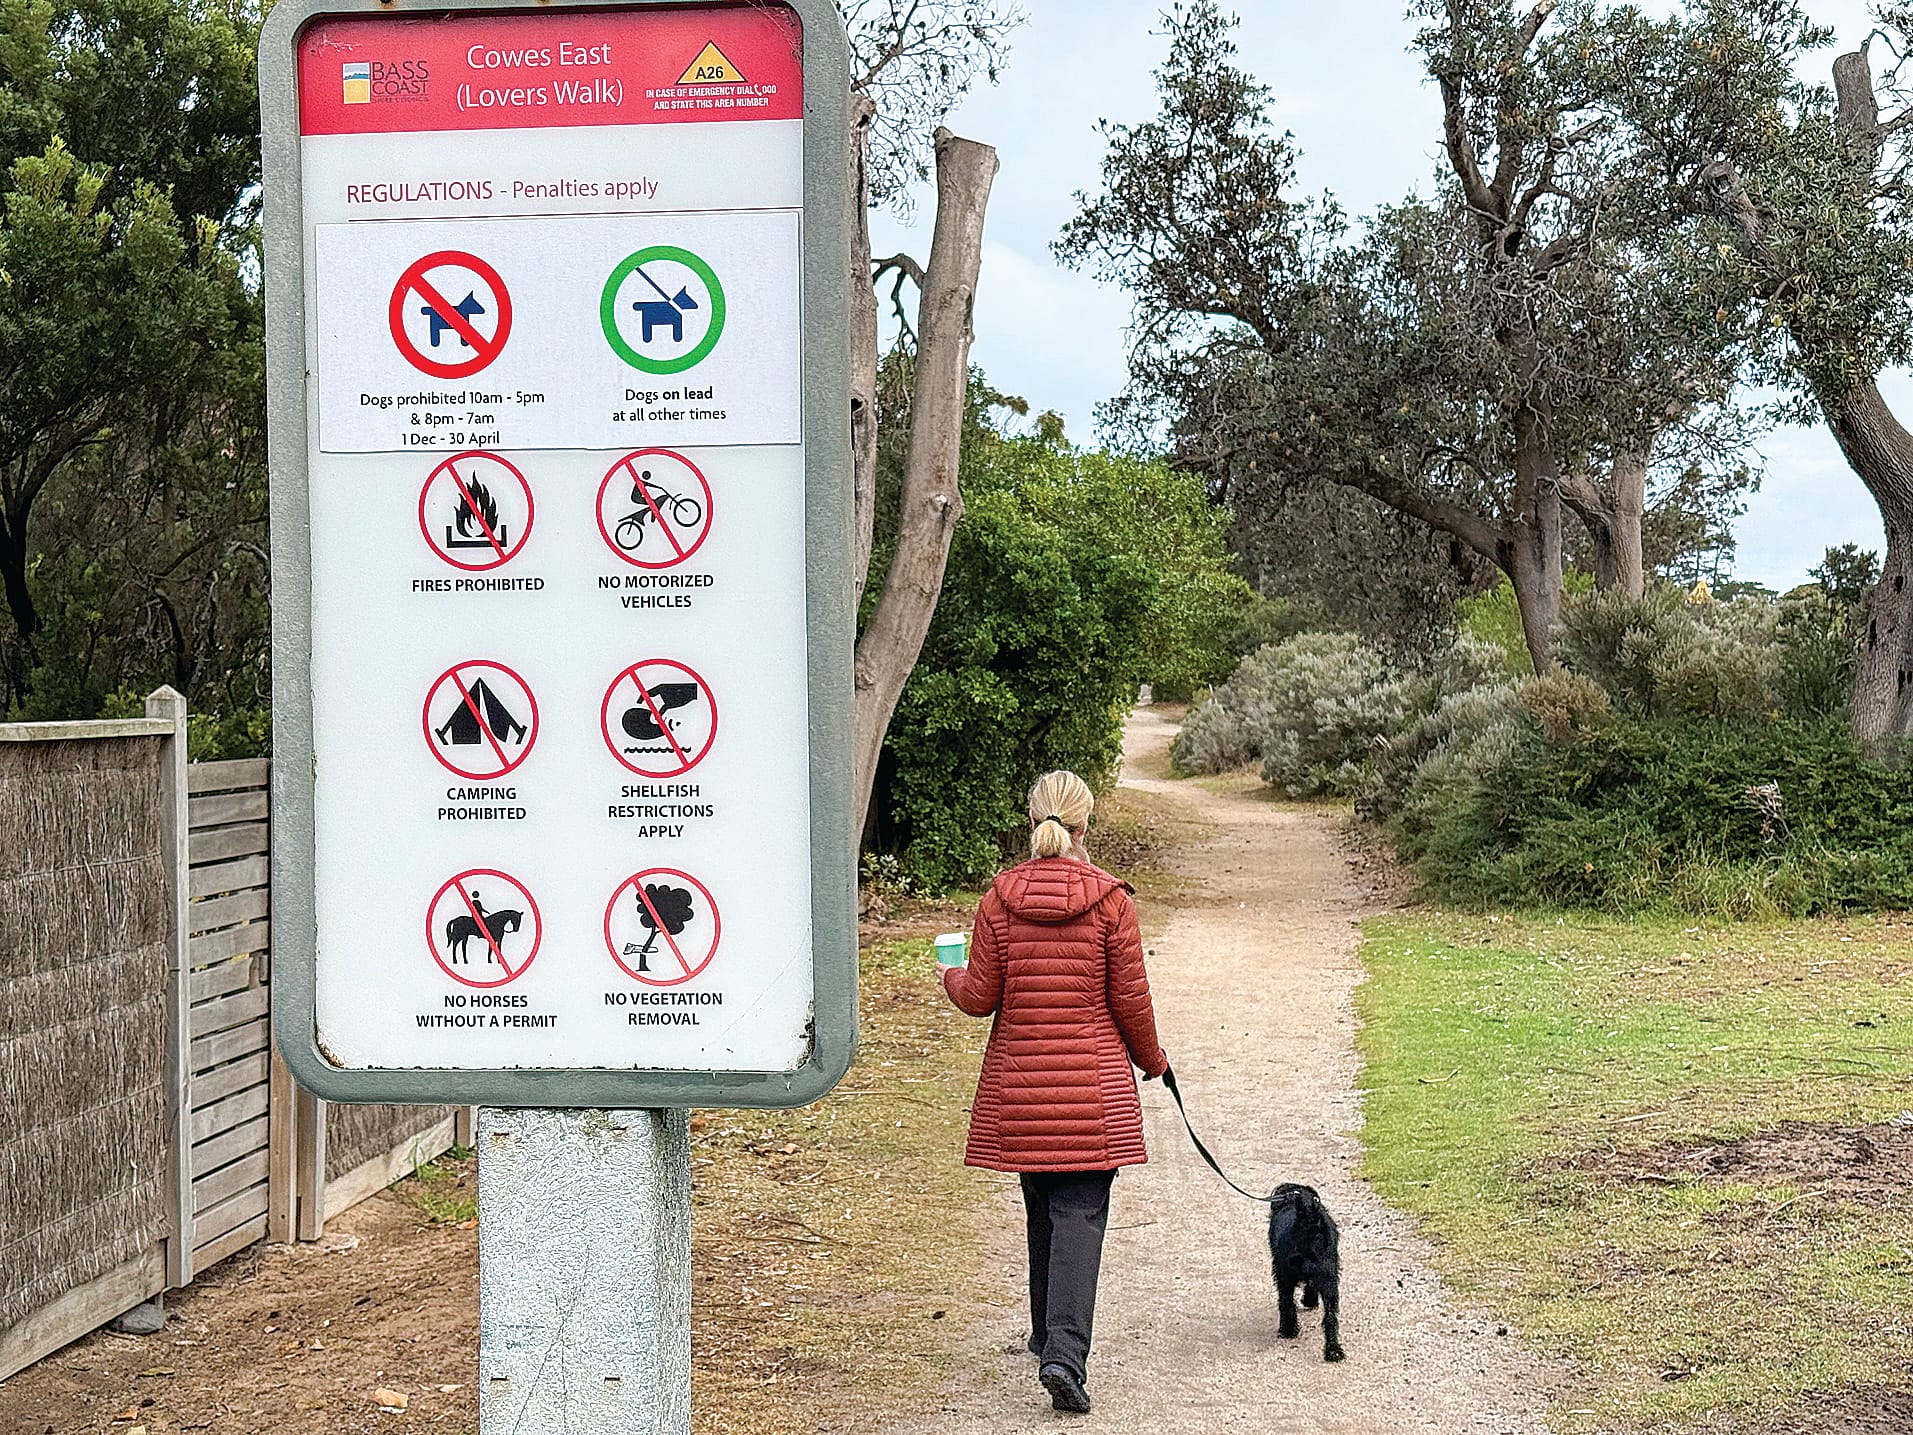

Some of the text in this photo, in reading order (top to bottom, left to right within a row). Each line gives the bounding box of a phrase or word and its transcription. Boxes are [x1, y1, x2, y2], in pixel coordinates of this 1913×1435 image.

[467, 42, 611, 69] Cowes East
[372, 61, 429, 80] BASS
[695, 66, 724, 79] A26
[372, 80, 428, 95] COAST
[457, 79, 623, 110] (Lovers Walk)
[646, 89, 654, 98] IN
[656, 89, 675, 98] CASE
[677, 88, 688, 97] OF
[689, 86, 735, 96] EMERGENCY
[737, 85, 754, 95] DIAL
[654, 98, 768, 110] AND STATE THIS AREA NUMBER
[348, 181, 492, 203] REGULATIONS
[513, 178, 599, 199] Penalties
[604, 175, 659, 201] apply
[360, 393, 394, 410] Dogs
[396, 390, 466, 410] prohibited
[468, 391, 503, 405] 10am
[515, 390, 545, 408] 5pm
[625, 385, 714, 405] Dogs on lead
[410, 412, 422, 426] &
[424, 412, 455, 429] 8pm
[465, 411, 495, 425] 7am
[612, 406, 727, 422] at all other times
[401, 433, 407, 446] 1
[410, 432, 437, 446] Dec
[448, 432, 465, 445] 30
[468, 430, 501, 448] April
[412, 577, 545, 593] FIRES PROHIBITED
[598, 574, 714, 589] NO MOTORIZED
[620, 594, 692, 609] VEHICLES
[446, 787, 517, 801] CAMPING
[620, 784, 700, 798] SHELLFISH
[437, 807, 527, 821] PROHIBITED
[608, 804, 714, 819] RESTRICTIONS
[637, 824, 685, 838] APPLY
[444, 994, 528, 1008] NO HORSES
[604, 992, 723, 1006] NO VEGETATION
[415, 1014, 558, 1028] WITHOUT A PERMIT
[628, 1012, 701, 1026] REMOVAL
